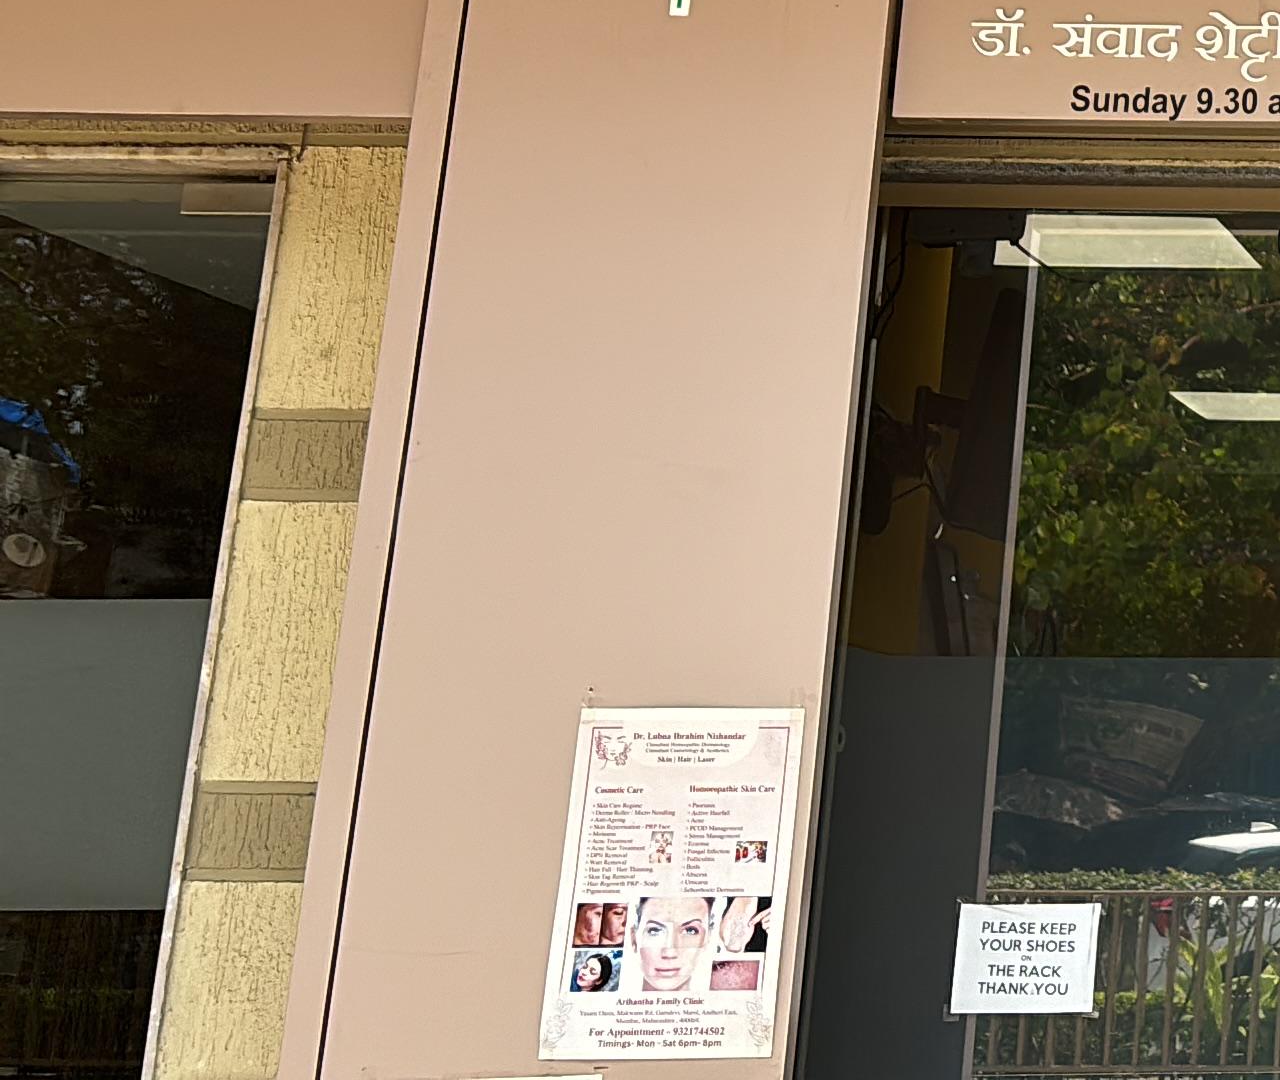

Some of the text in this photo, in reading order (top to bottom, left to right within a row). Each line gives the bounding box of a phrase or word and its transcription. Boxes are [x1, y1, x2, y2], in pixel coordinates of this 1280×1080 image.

[971, 8, 1032, 58] डॉ.
[1052, 14, 1182, 62] संवाद
[1071, 84, 1187, 121] Sunday
[1196, 88, 1258, 115] 9.30
[981, 921, 1077, 936] PLEASE KEEP
[979, 938, 1076, 953] YOUR SHOES
[1020, 954, 1033, 962] ON
[987, 964, 1063, 978] THE RACK
[977, 981, 1069, 996] THANK YOU
[588, 1028, 605, 1037] For
[607, 1027, 665, 1039] Appointment
[672, 1026, 726, 1037] 9321744502
[636, 1039, 656, 1048] Mon
[662, 1039, 676, 1047] Sat
